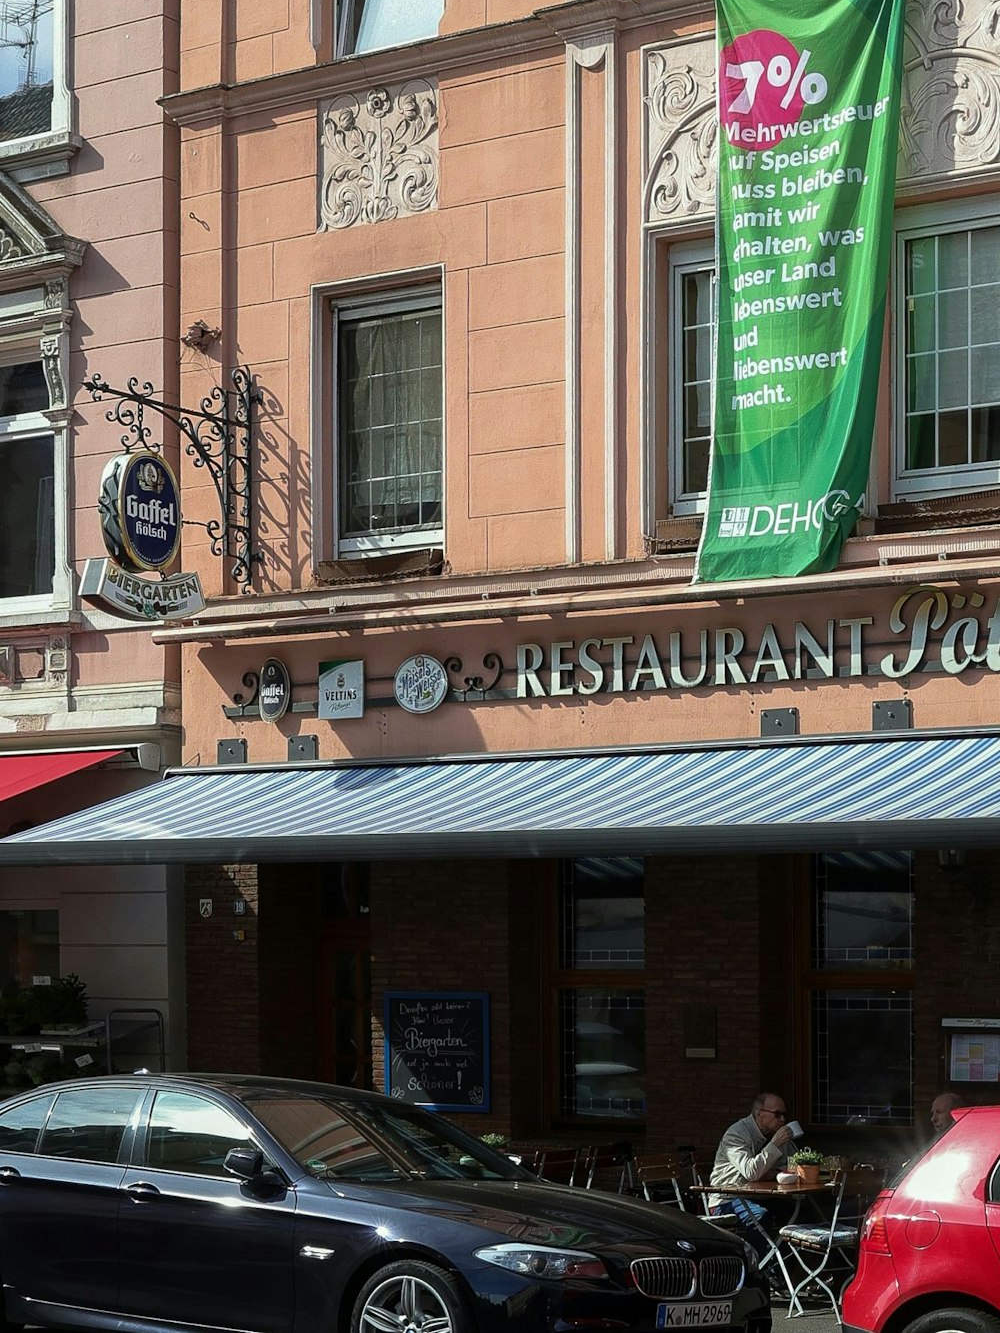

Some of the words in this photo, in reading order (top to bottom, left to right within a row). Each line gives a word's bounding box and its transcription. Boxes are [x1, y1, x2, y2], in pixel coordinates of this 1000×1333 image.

[726, 49, 828, 114] 7%
[760, 139, 840, 174] Speisen
[781, 166, 869, 198] bleiben,
[787, 201, 821, 226] wir
[818, 226, 864, 247] was
[781, 255, 836, 283] Land
[734, 325, 758, 352] und
[733, 346, 847, 382] liebenswert
[731, 383, 791, 410] macht.
[126, 494, 176, 527] Gaffel
[135, 520, 167, 541] Kölsch
[106, 567, 199, 602] BIERGARTEN
[516, 616, 874, 699] RESTAURANT
[261, 684, 284, 697] Gaffel
[325, 689, 357, 701] VELTINS
[404, 1027, 467, 1057] Biergarten
[667, 1307, 676, 1325] K
[684, 1306, 701, 1324] MH
[702, 1305, 731, 1323] 2969
